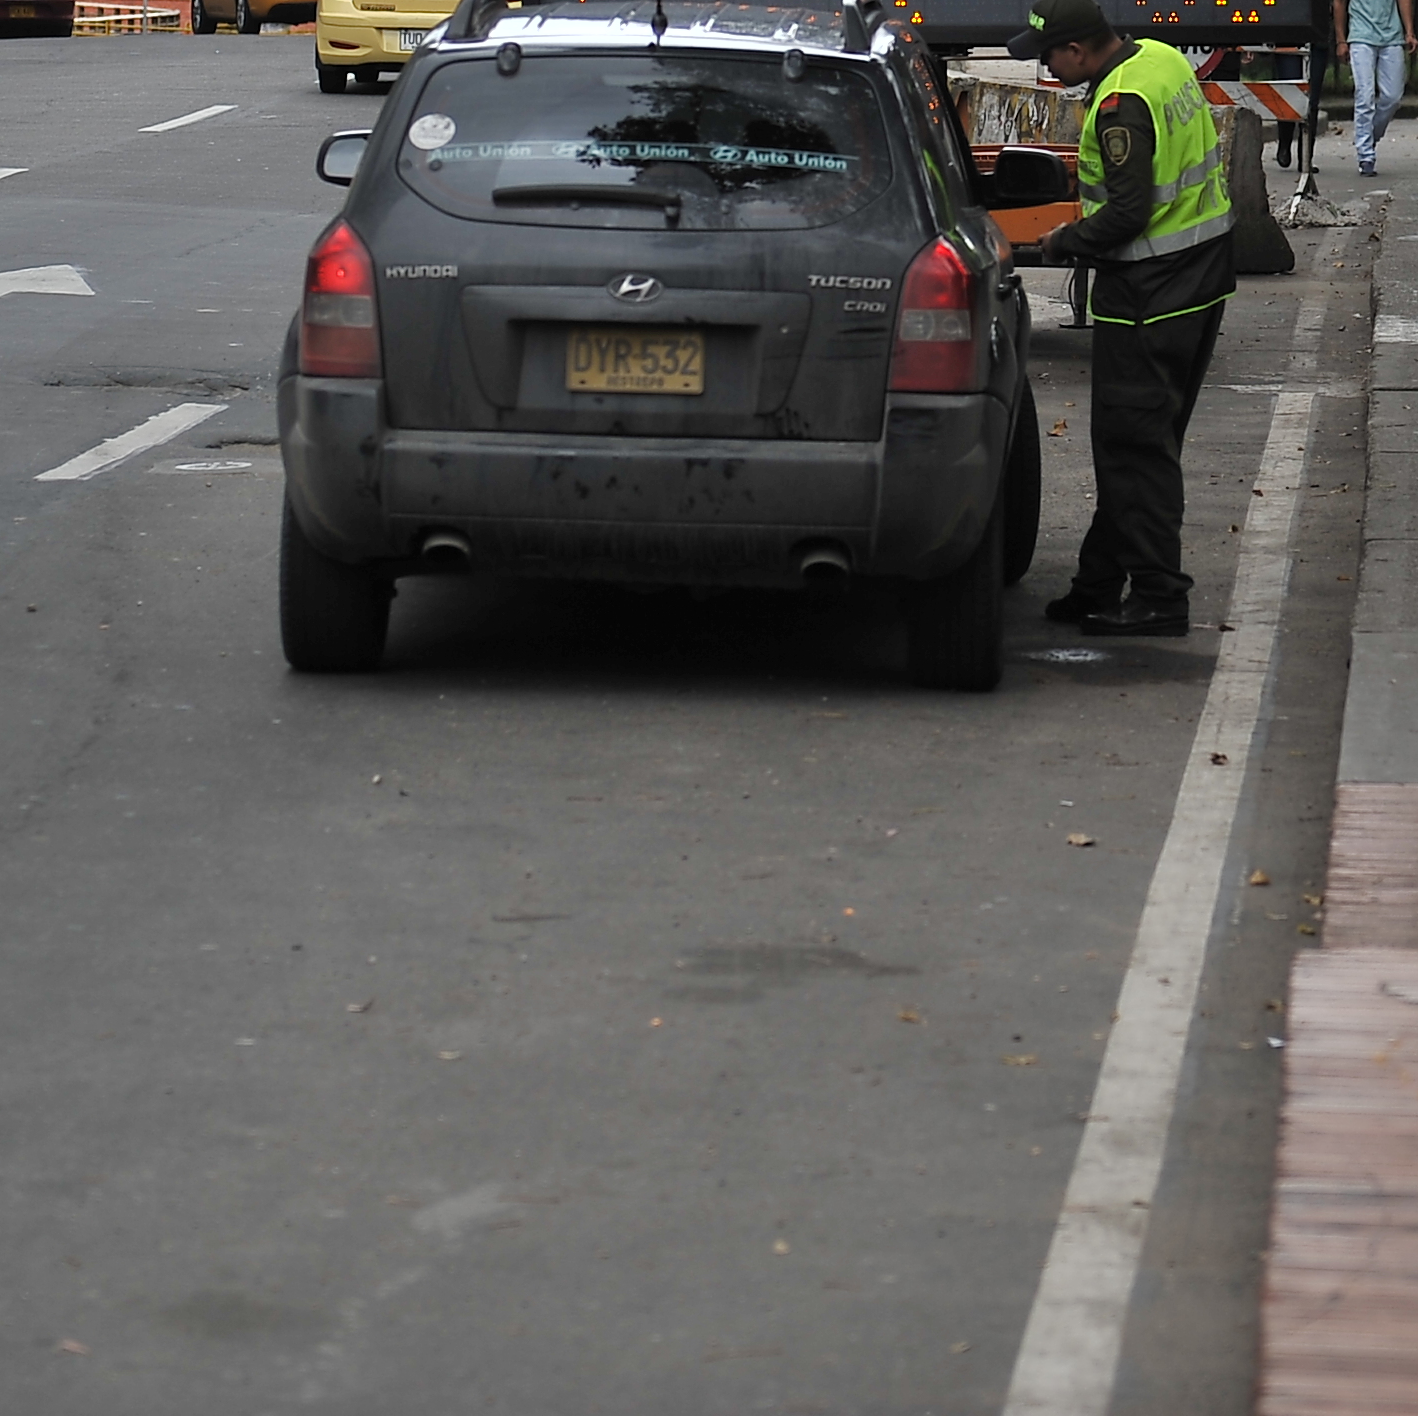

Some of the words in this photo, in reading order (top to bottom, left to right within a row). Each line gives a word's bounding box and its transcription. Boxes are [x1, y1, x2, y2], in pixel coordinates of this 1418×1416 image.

[432, 146, 472, 160] Auto
[638, 143, 689, 159] Unión
[745, 149, 788, 165] Auto
[794, 149, 848, 170] Unión
[385, 265, 458, 279] HYUNDAI
[807, 274, 892, 290] TUCSON
[574, 327, 700, 377] DYR-532
